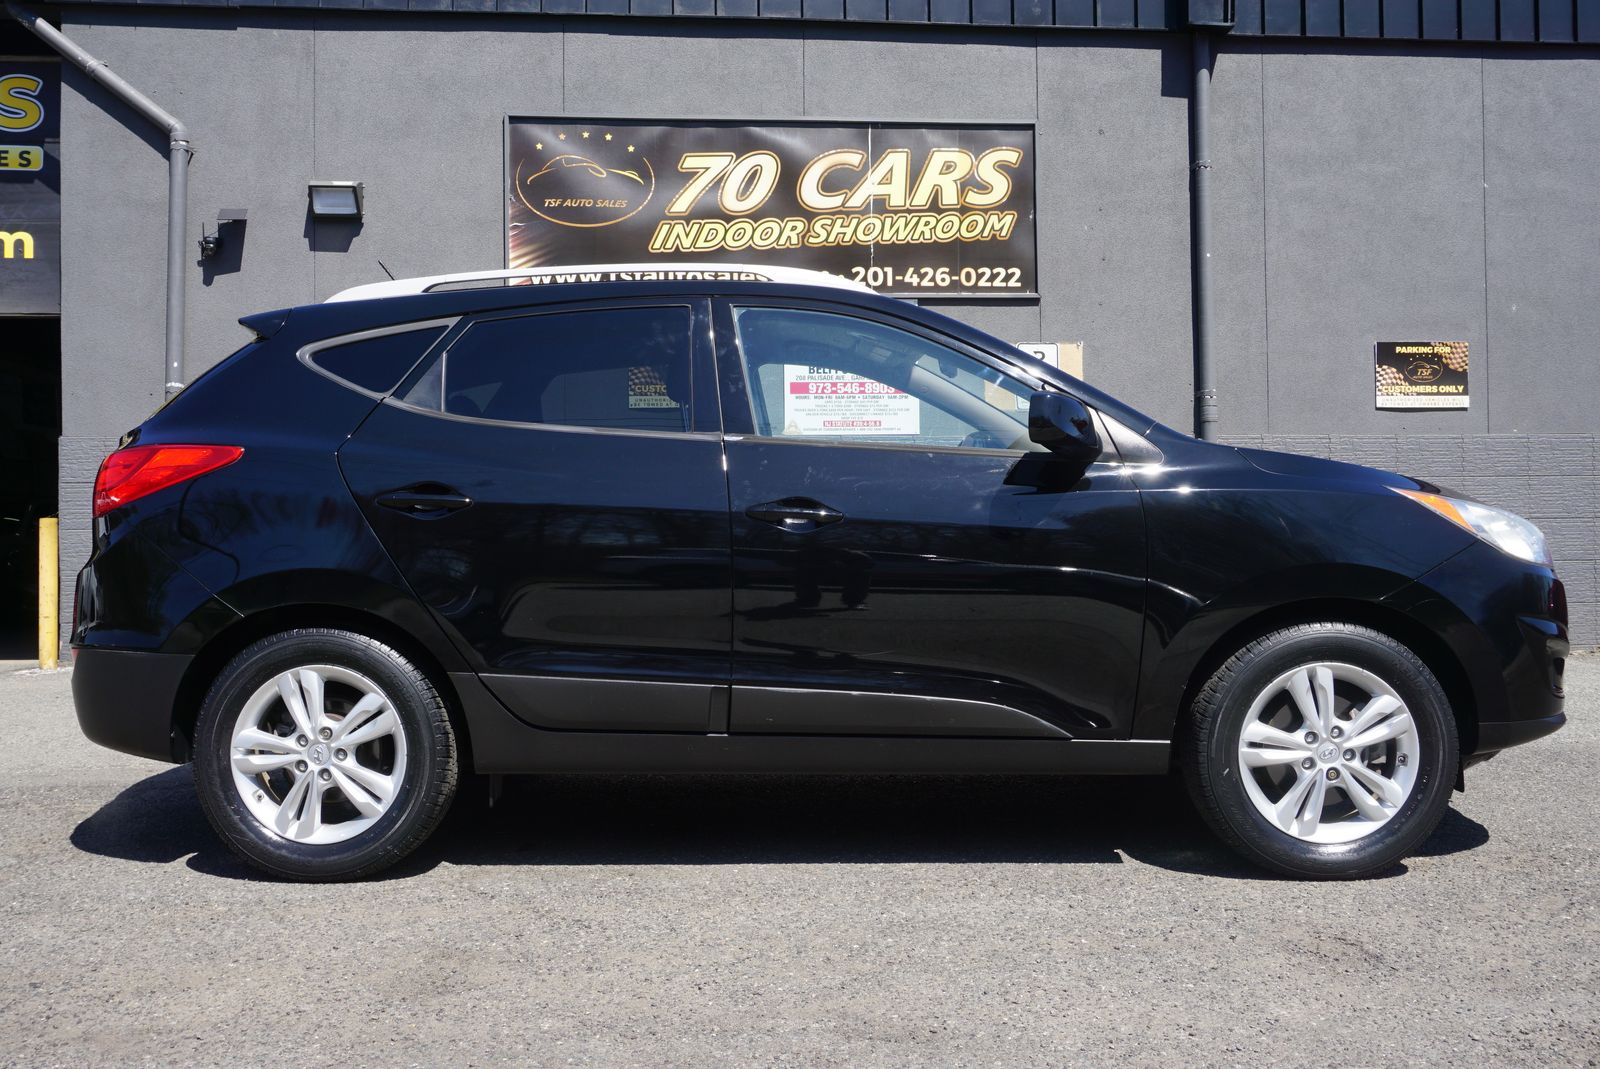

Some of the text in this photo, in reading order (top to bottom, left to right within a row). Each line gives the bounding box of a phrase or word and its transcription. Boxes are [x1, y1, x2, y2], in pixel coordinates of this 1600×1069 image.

[665, 147, 1023, 216] 70 CARS
[544, 199, 628, 208] TSF AUTO SALES
[648, 211, 1017, 252] INDOOR SHOWROOM
[851, 266, 1021, 287] 201-426-0222
[1395, 346, 1451, 354] PARKING FOR
[1417, 368, 1433, 376] TSF
[1382, 385, 1464, 393] CUSTOMERS ONLY
